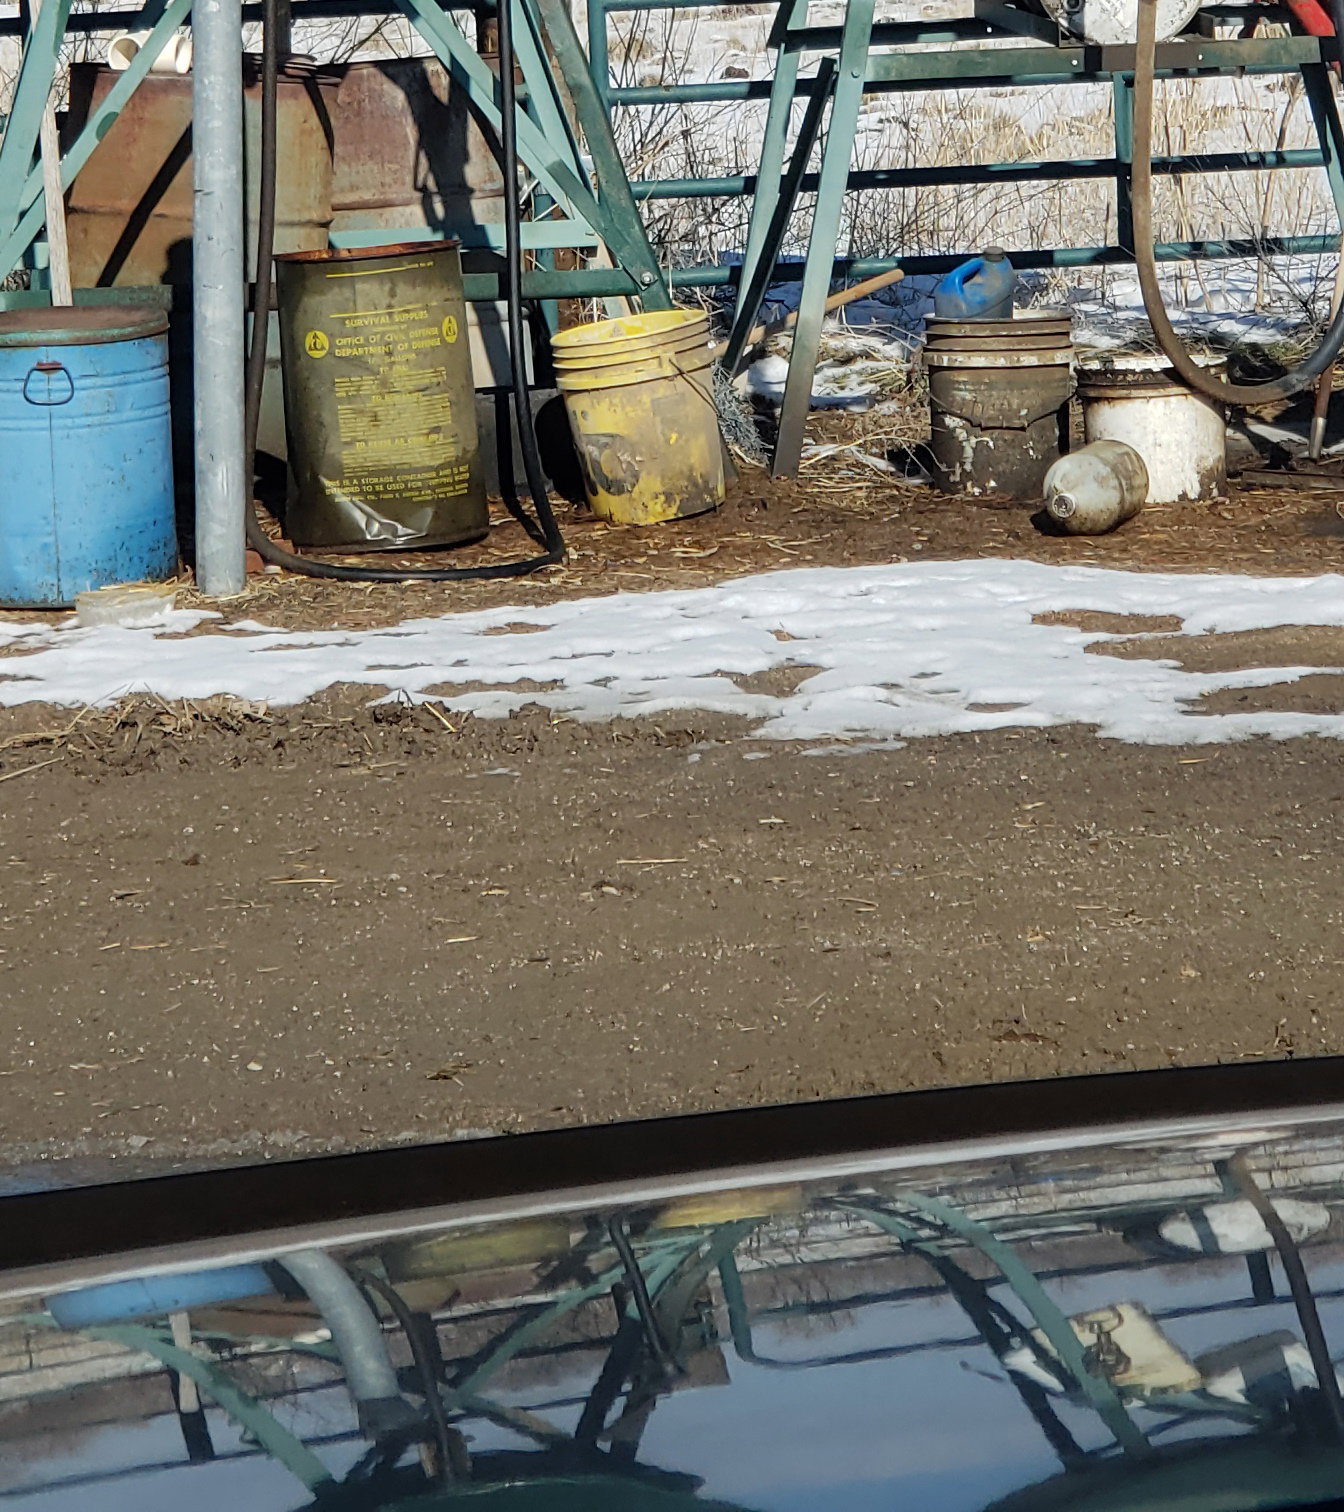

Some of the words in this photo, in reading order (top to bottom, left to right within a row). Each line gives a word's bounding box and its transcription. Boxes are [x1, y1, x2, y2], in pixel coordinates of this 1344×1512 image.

[345, 316, 390, 328] SURVIVAL
[336, 335, 365, 346] OFFICE
[335, 344, 393, 357] DEPARTMENT
